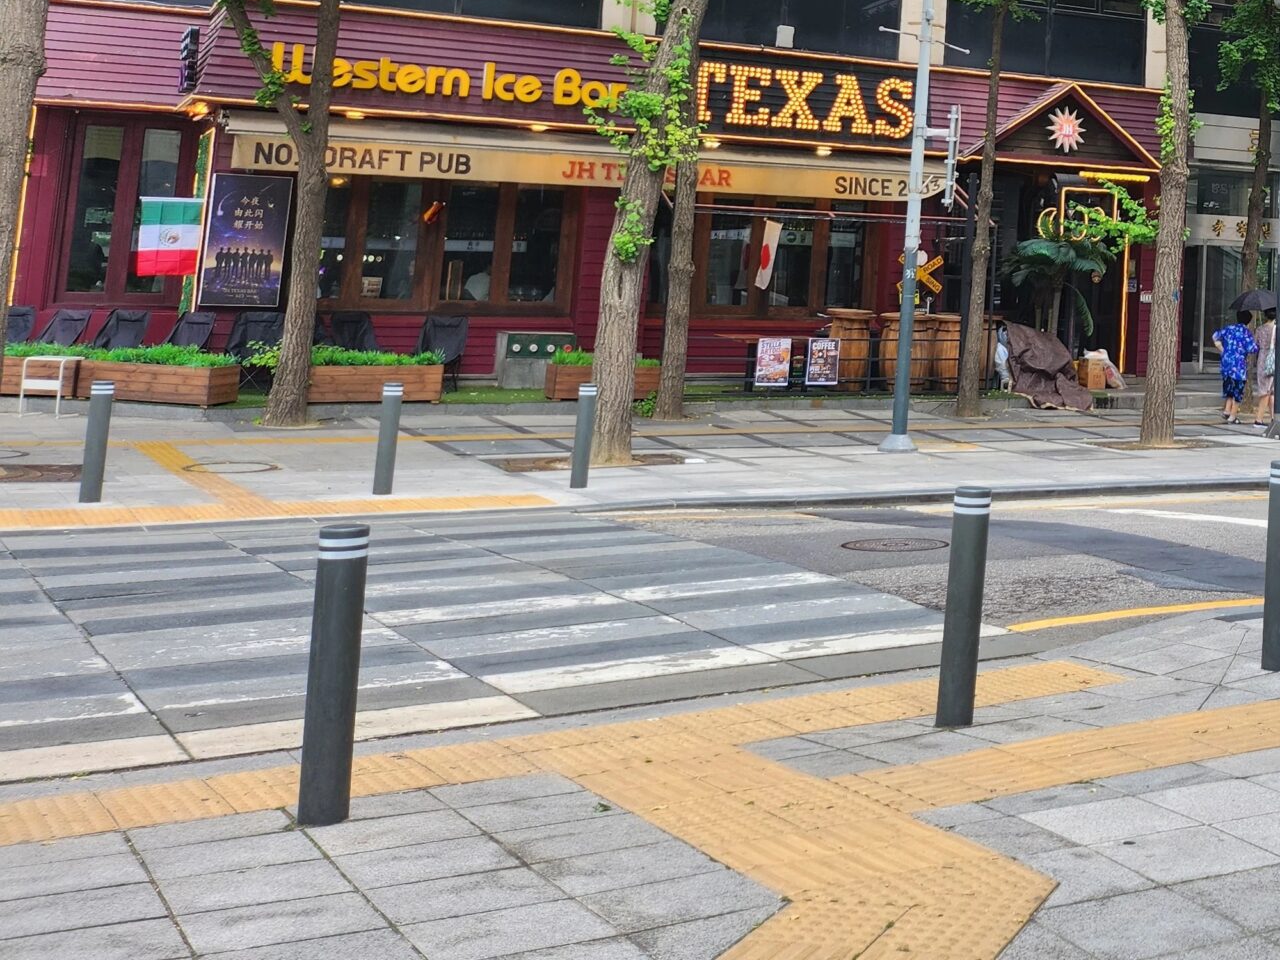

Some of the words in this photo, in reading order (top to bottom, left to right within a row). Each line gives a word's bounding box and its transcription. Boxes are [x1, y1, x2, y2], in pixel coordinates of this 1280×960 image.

[272, 41, 470, 97] Western
[482, 61, 543, 103] Ice
[553, 68, 628, 110] Bar
[697, 61, 915, 139] TEXAS
[325, 143, 412, 172] DRAFT
[419, 151, 472, 175] PUB
[562, 160, 596, 180] JH
[834, 175, 893, 197] SINCE
[240, 195, 260, 206] 今夜
[234, 208, 264, 219] 由此闪
[233, 219, 264, 230] 耀开始
[812, 341, 836, 350] COFFEE
